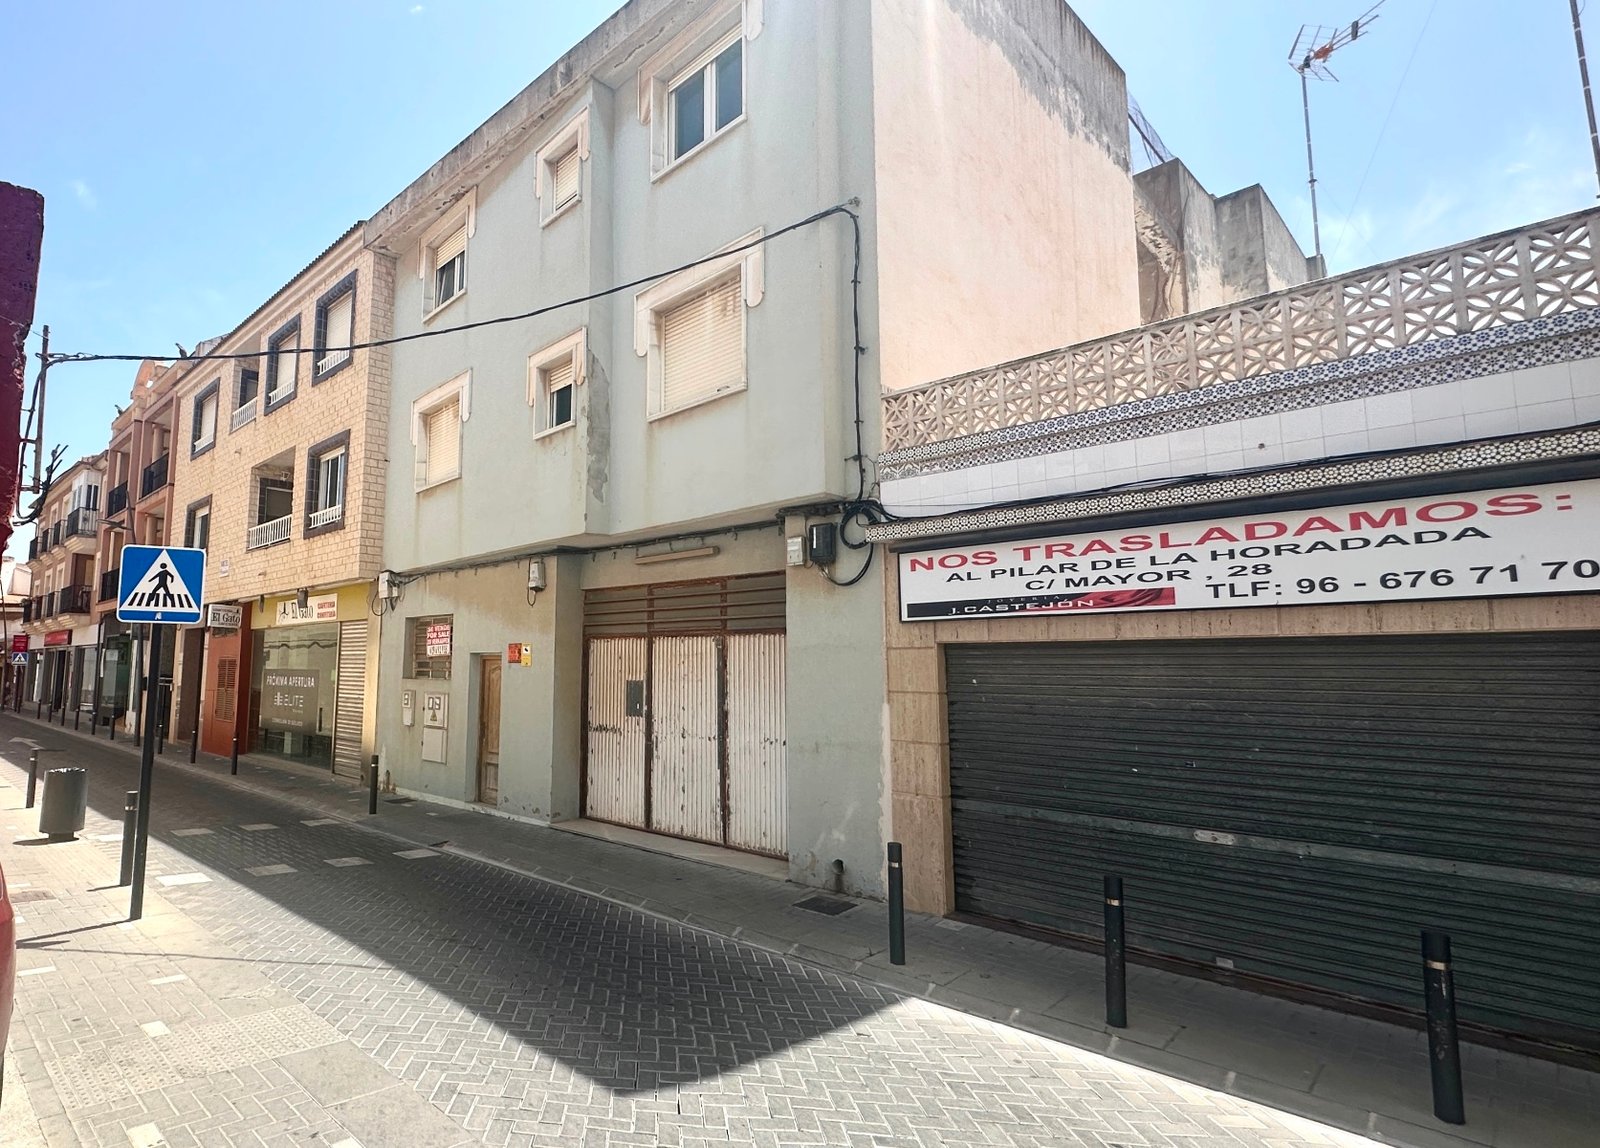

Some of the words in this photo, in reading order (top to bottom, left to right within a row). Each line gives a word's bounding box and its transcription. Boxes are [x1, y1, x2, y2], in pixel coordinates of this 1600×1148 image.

[909, 552, 998, 571] NOS
[1012, 493, 1574, 561] TRASLADAMOS:
[946, 571, 975, 583] AL
[990, 562, 1079, 579] PILAR
[1090, 557, 1137, 571] DE
[1149, 552, 1199, 566] LA
[1210, 526, 1493, 562] HORADADA
[1025, 578, 1052, 591] C/
[1065, 569, 1193, 588] MAYOR
[1227, 563, 1273, 578] 28
[1205, 579, 1283, 599] TLF:
[1296, 576, 1340, 594] 96
[1379, 568, 1455, 590] 676
[1469, 564, 1519, 584] 71
[1541, 559, 1600, 580] 70
[211, 612, 221, 622] El
[222, 613, 241, 624] Gato
[964, 598, 1094, 614] CASTEJÓN
